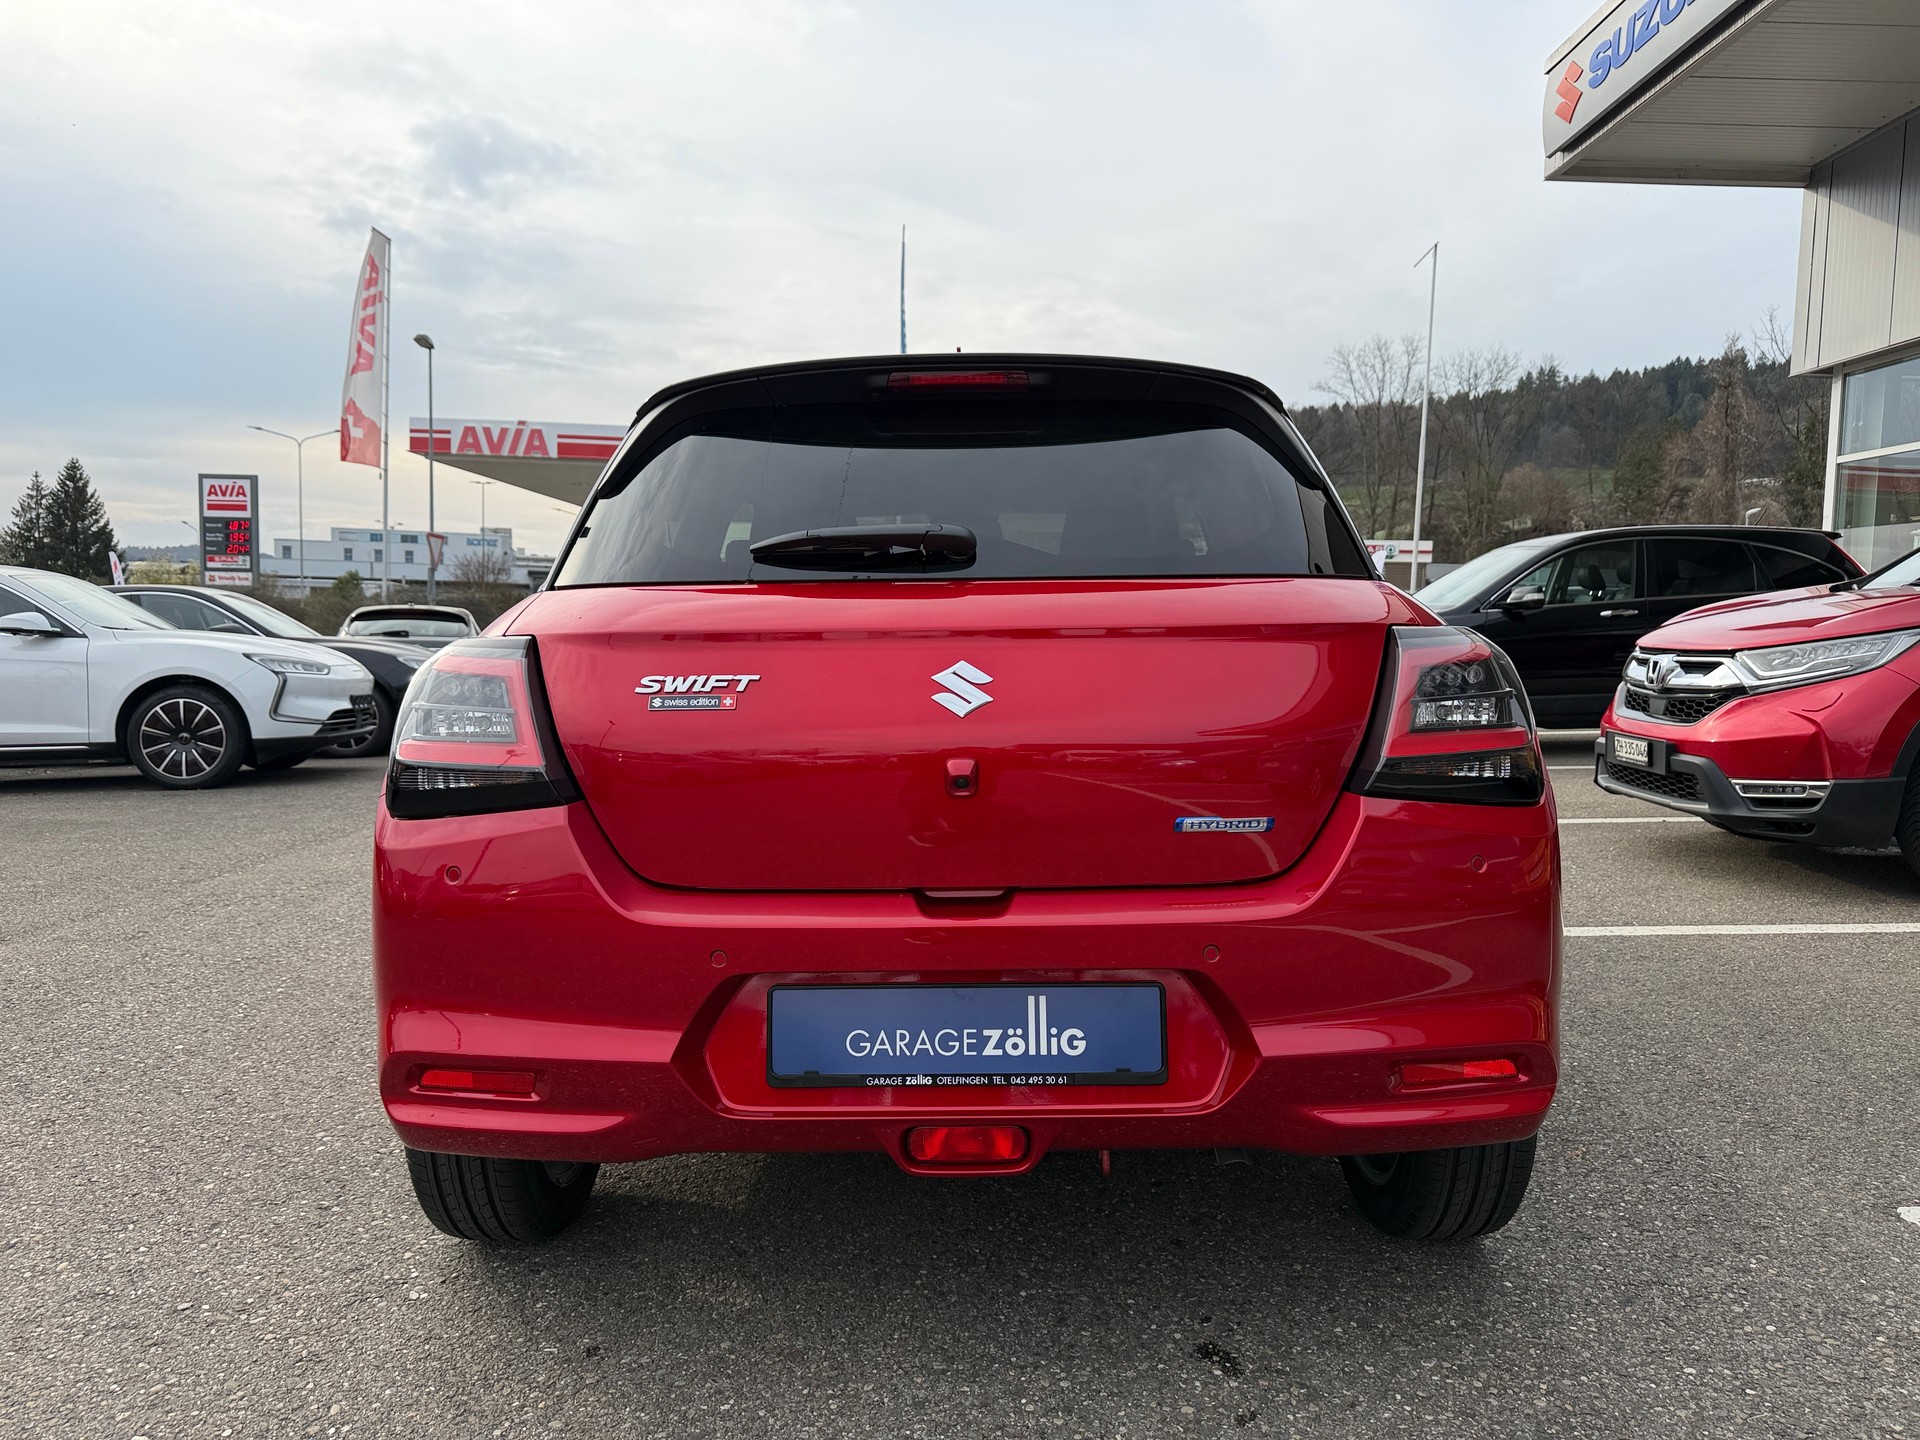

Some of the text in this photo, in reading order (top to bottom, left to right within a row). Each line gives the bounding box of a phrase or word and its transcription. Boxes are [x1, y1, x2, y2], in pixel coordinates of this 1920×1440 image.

[634, 674, 761, 694] SWIFT
[664, 697, 719, 706] swiss edition
[1188, 820, 1261, 829] HYBRID
[845, 1028, 977, 1057] GARAGE
[866, 1076, 902, 1086] GARAGE
[936, 1076, 988, 1085] OTELFINGEN
[1010, 1075, 1026, 1084] 043
[1027, 1075, 1043, 1084] 495
[1045, 1075, 1056, 1084] 30
[1057, 1075, 1067, 1084] 61
